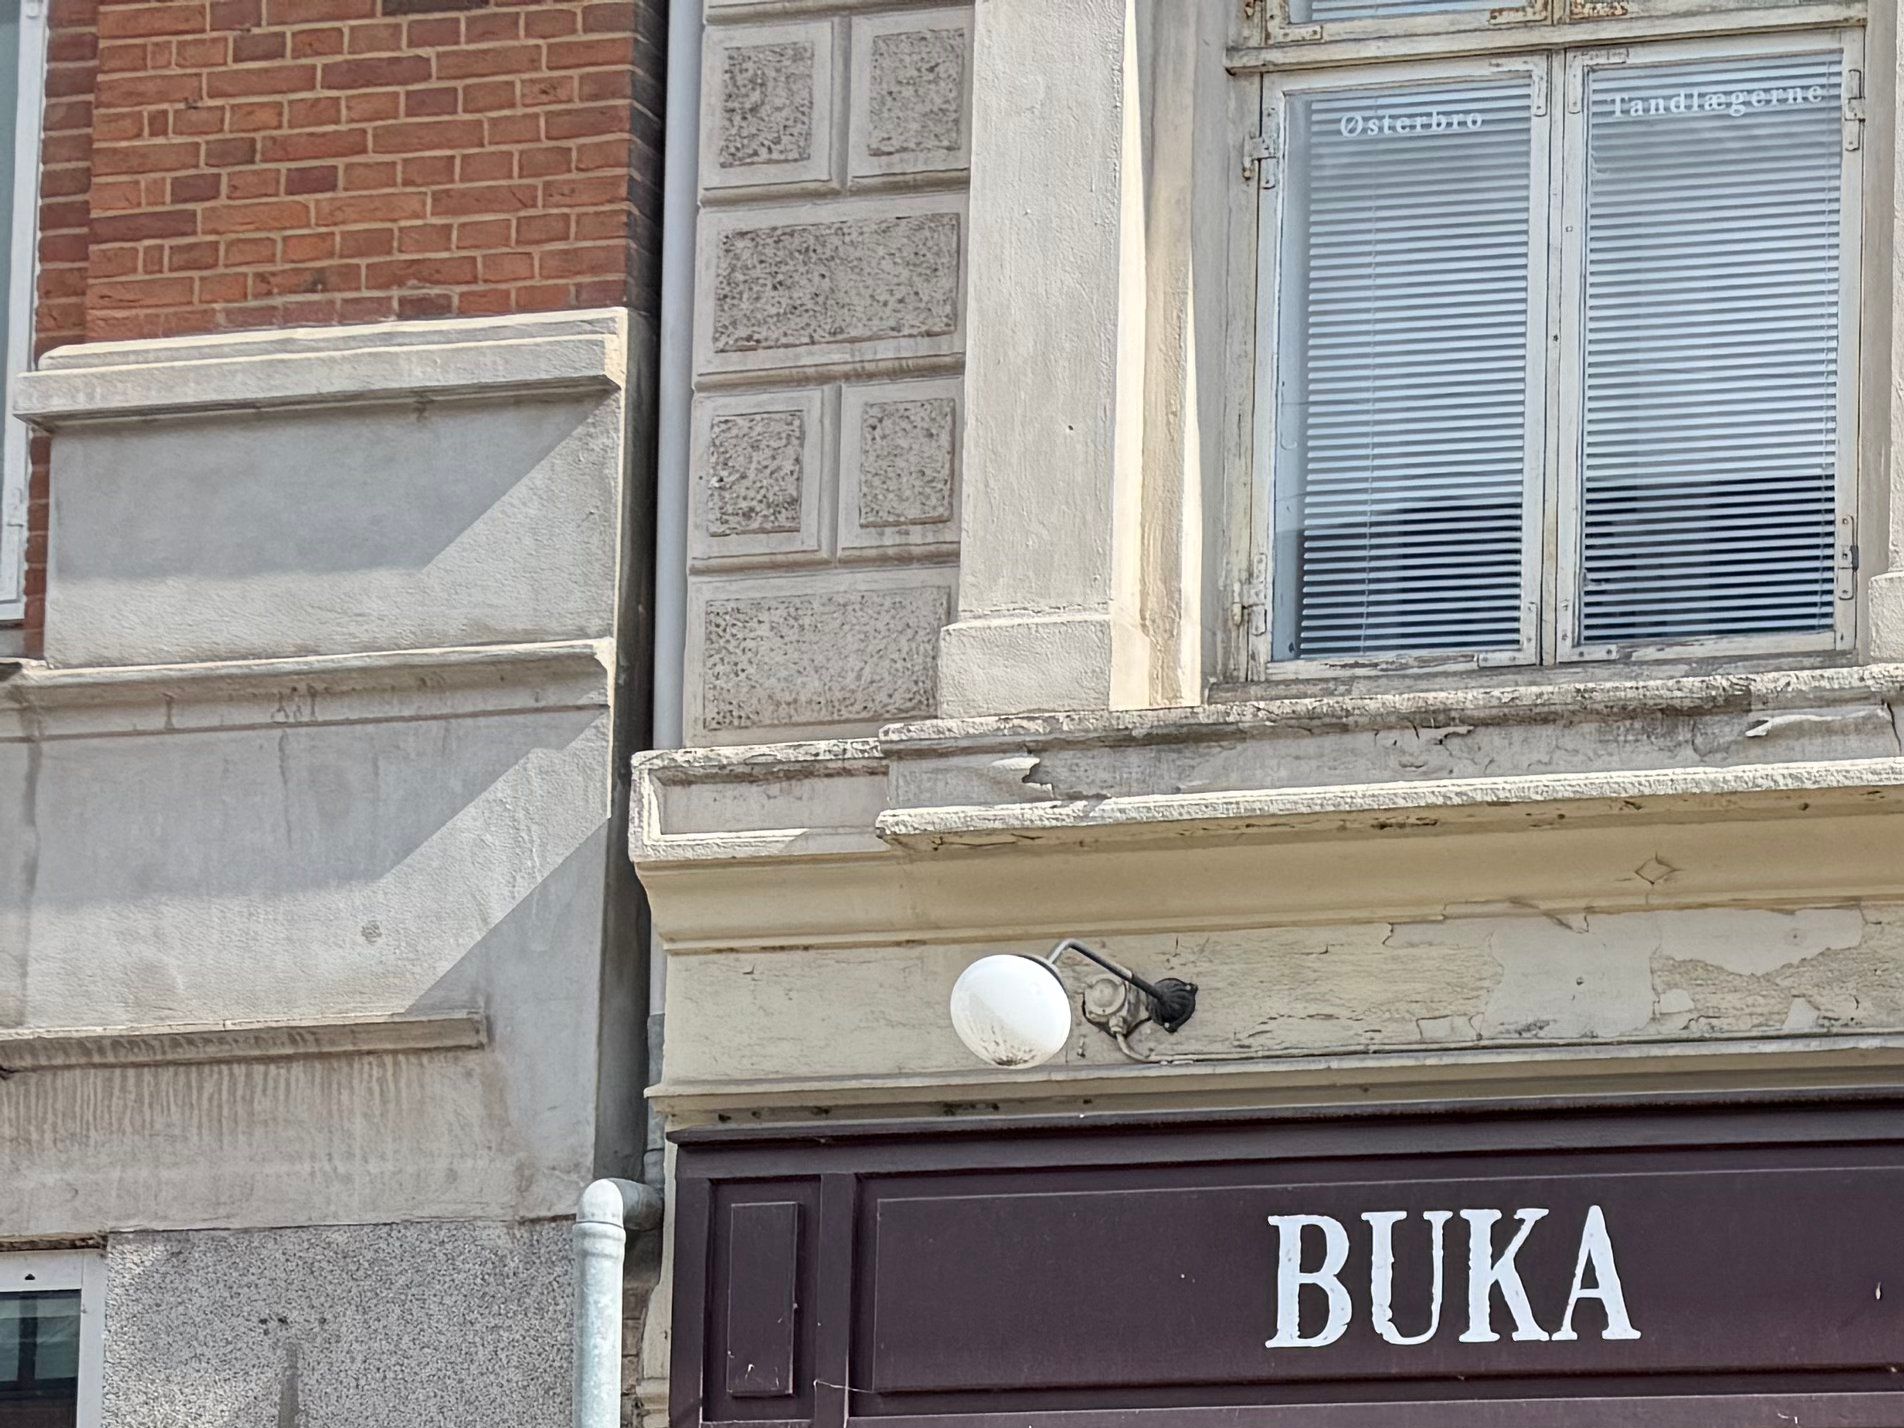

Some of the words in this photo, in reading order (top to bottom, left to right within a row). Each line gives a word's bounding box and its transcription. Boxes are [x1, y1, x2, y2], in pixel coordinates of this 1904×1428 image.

[1340, 111, 1483, 138] Østerbro
[1608, 84, 1824, 117] Tandlægerne
[1265, 1205, 1641, 1348] BUKA
